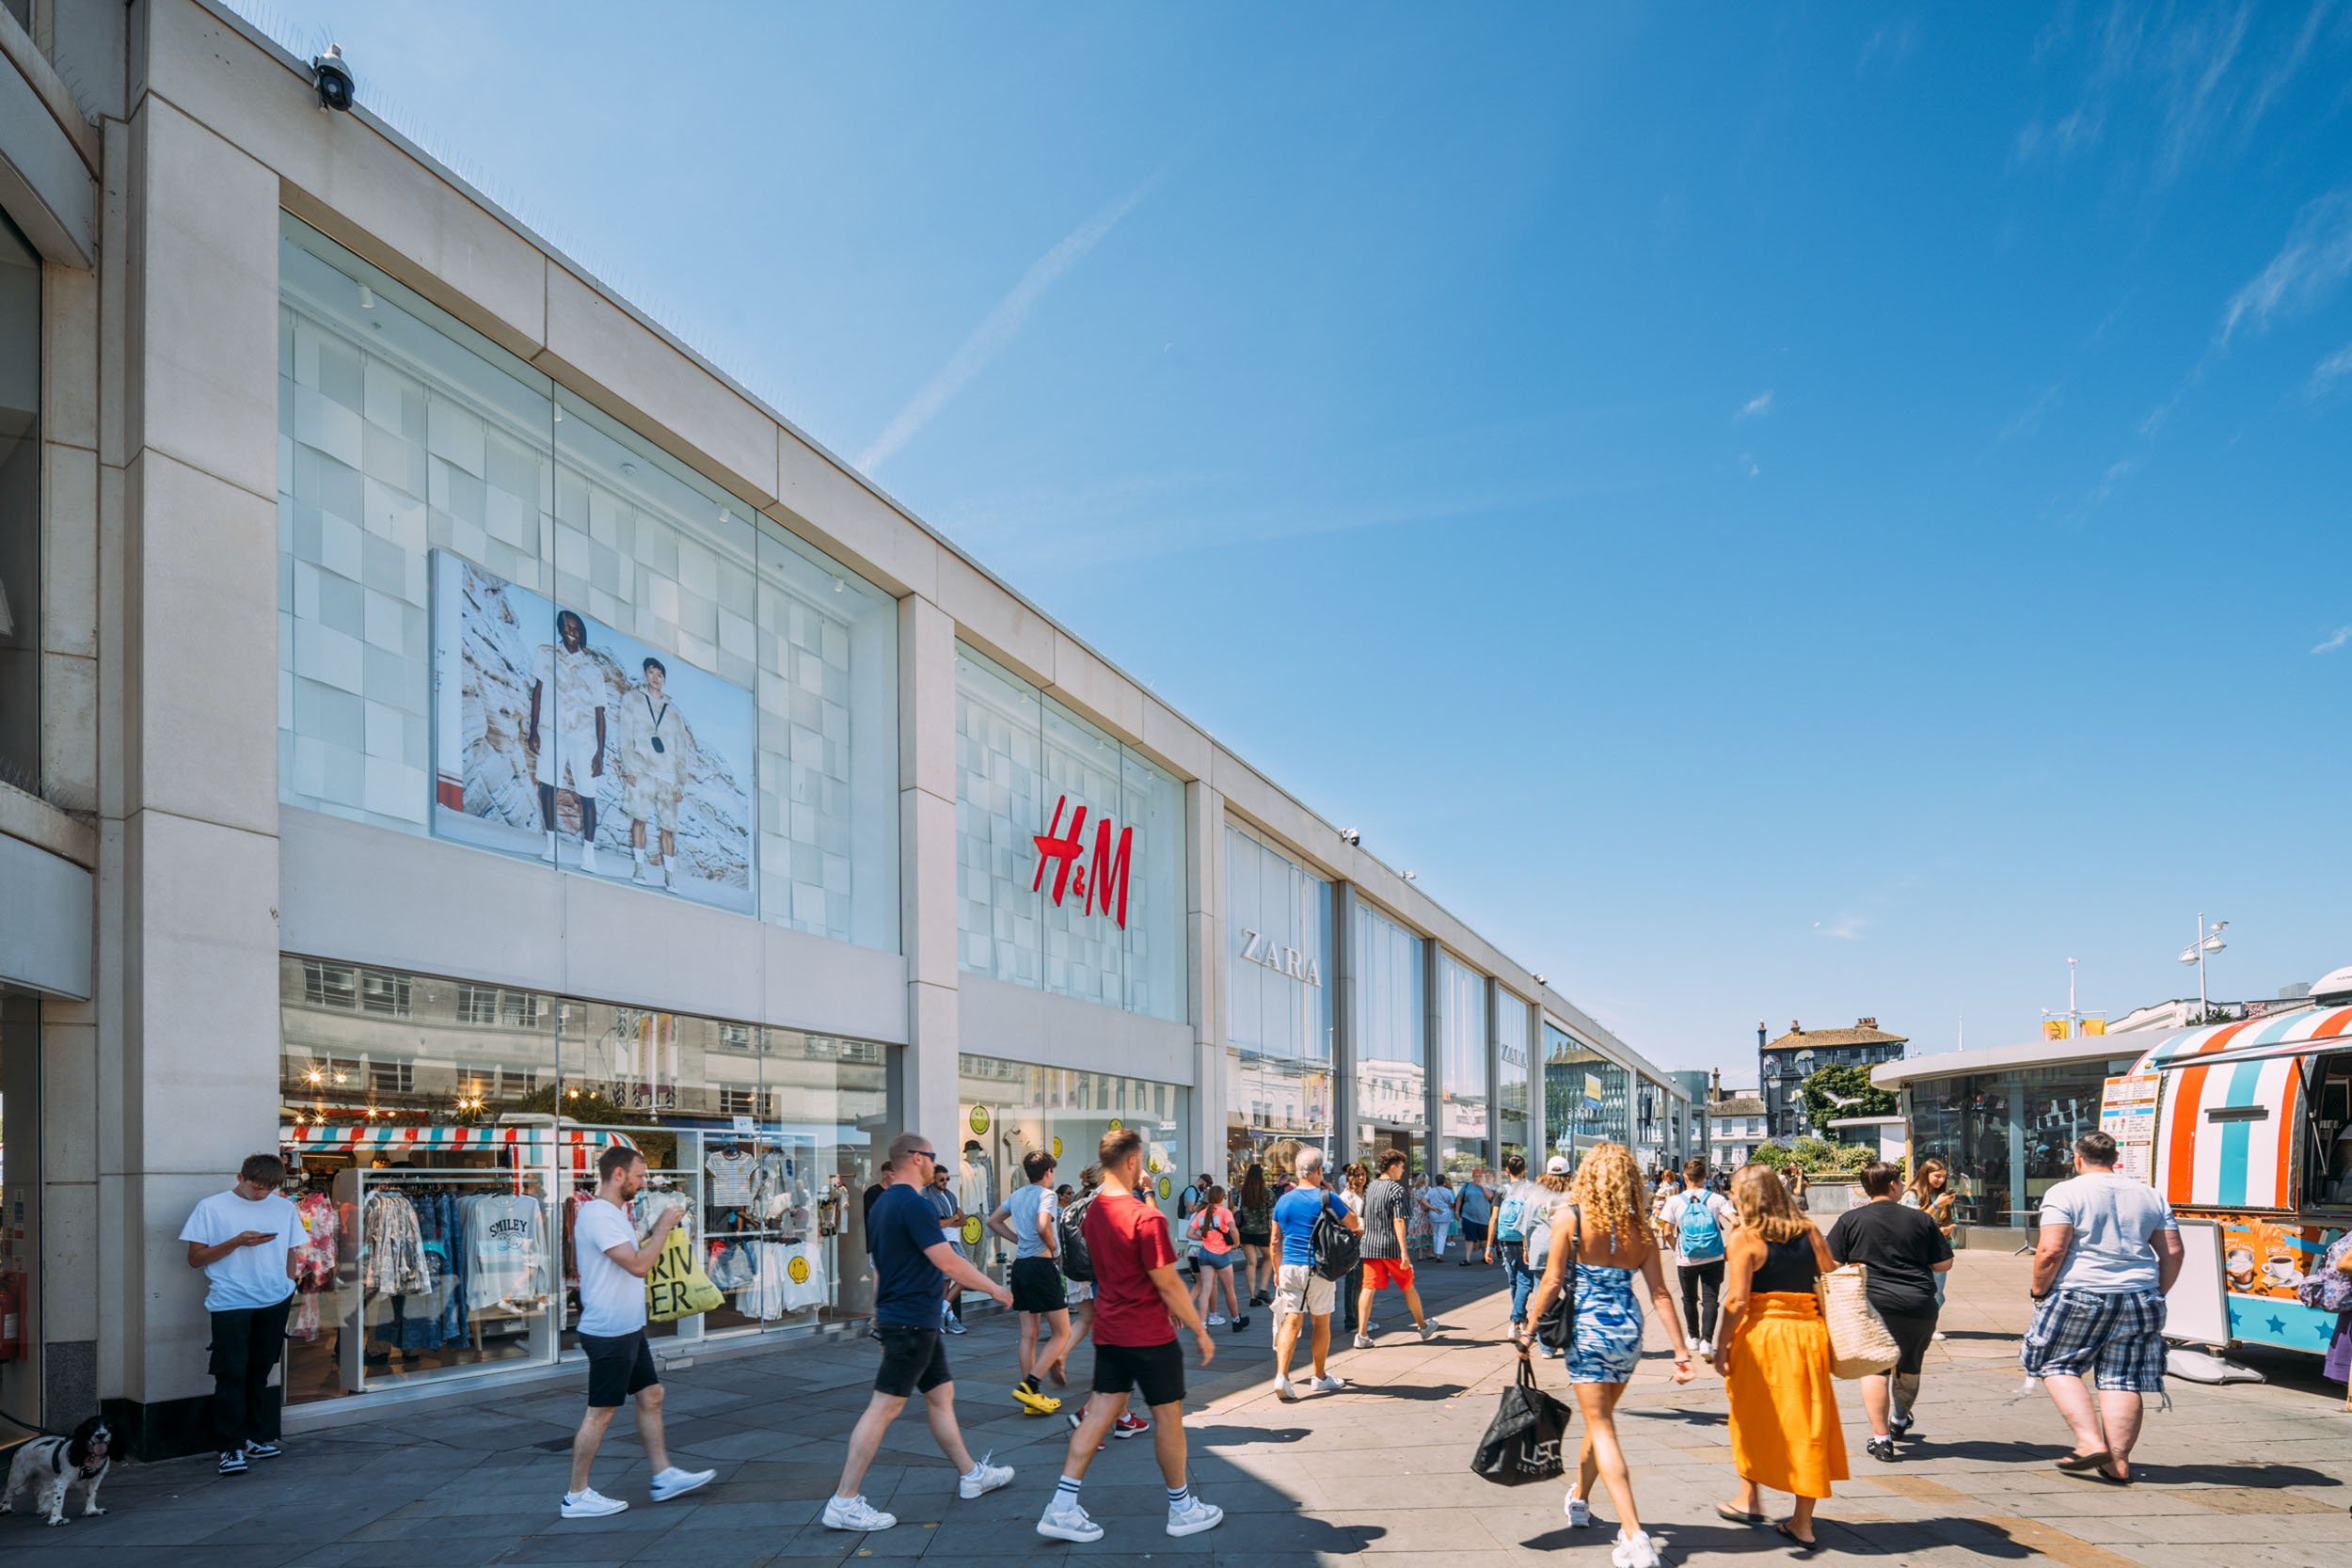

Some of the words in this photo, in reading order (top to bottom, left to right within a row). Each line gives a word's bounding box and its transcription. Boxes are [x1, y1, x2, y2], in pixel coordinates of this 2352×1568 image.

[1033, 795, 1133, 930] H&M
[1240, 928, 1322, 988] ZARA
[1501, 1043, 1529, 1069] ZARA
[489, 1218, 527, 1238] SMILEY
[650, 1280, 693, 1315] ER
